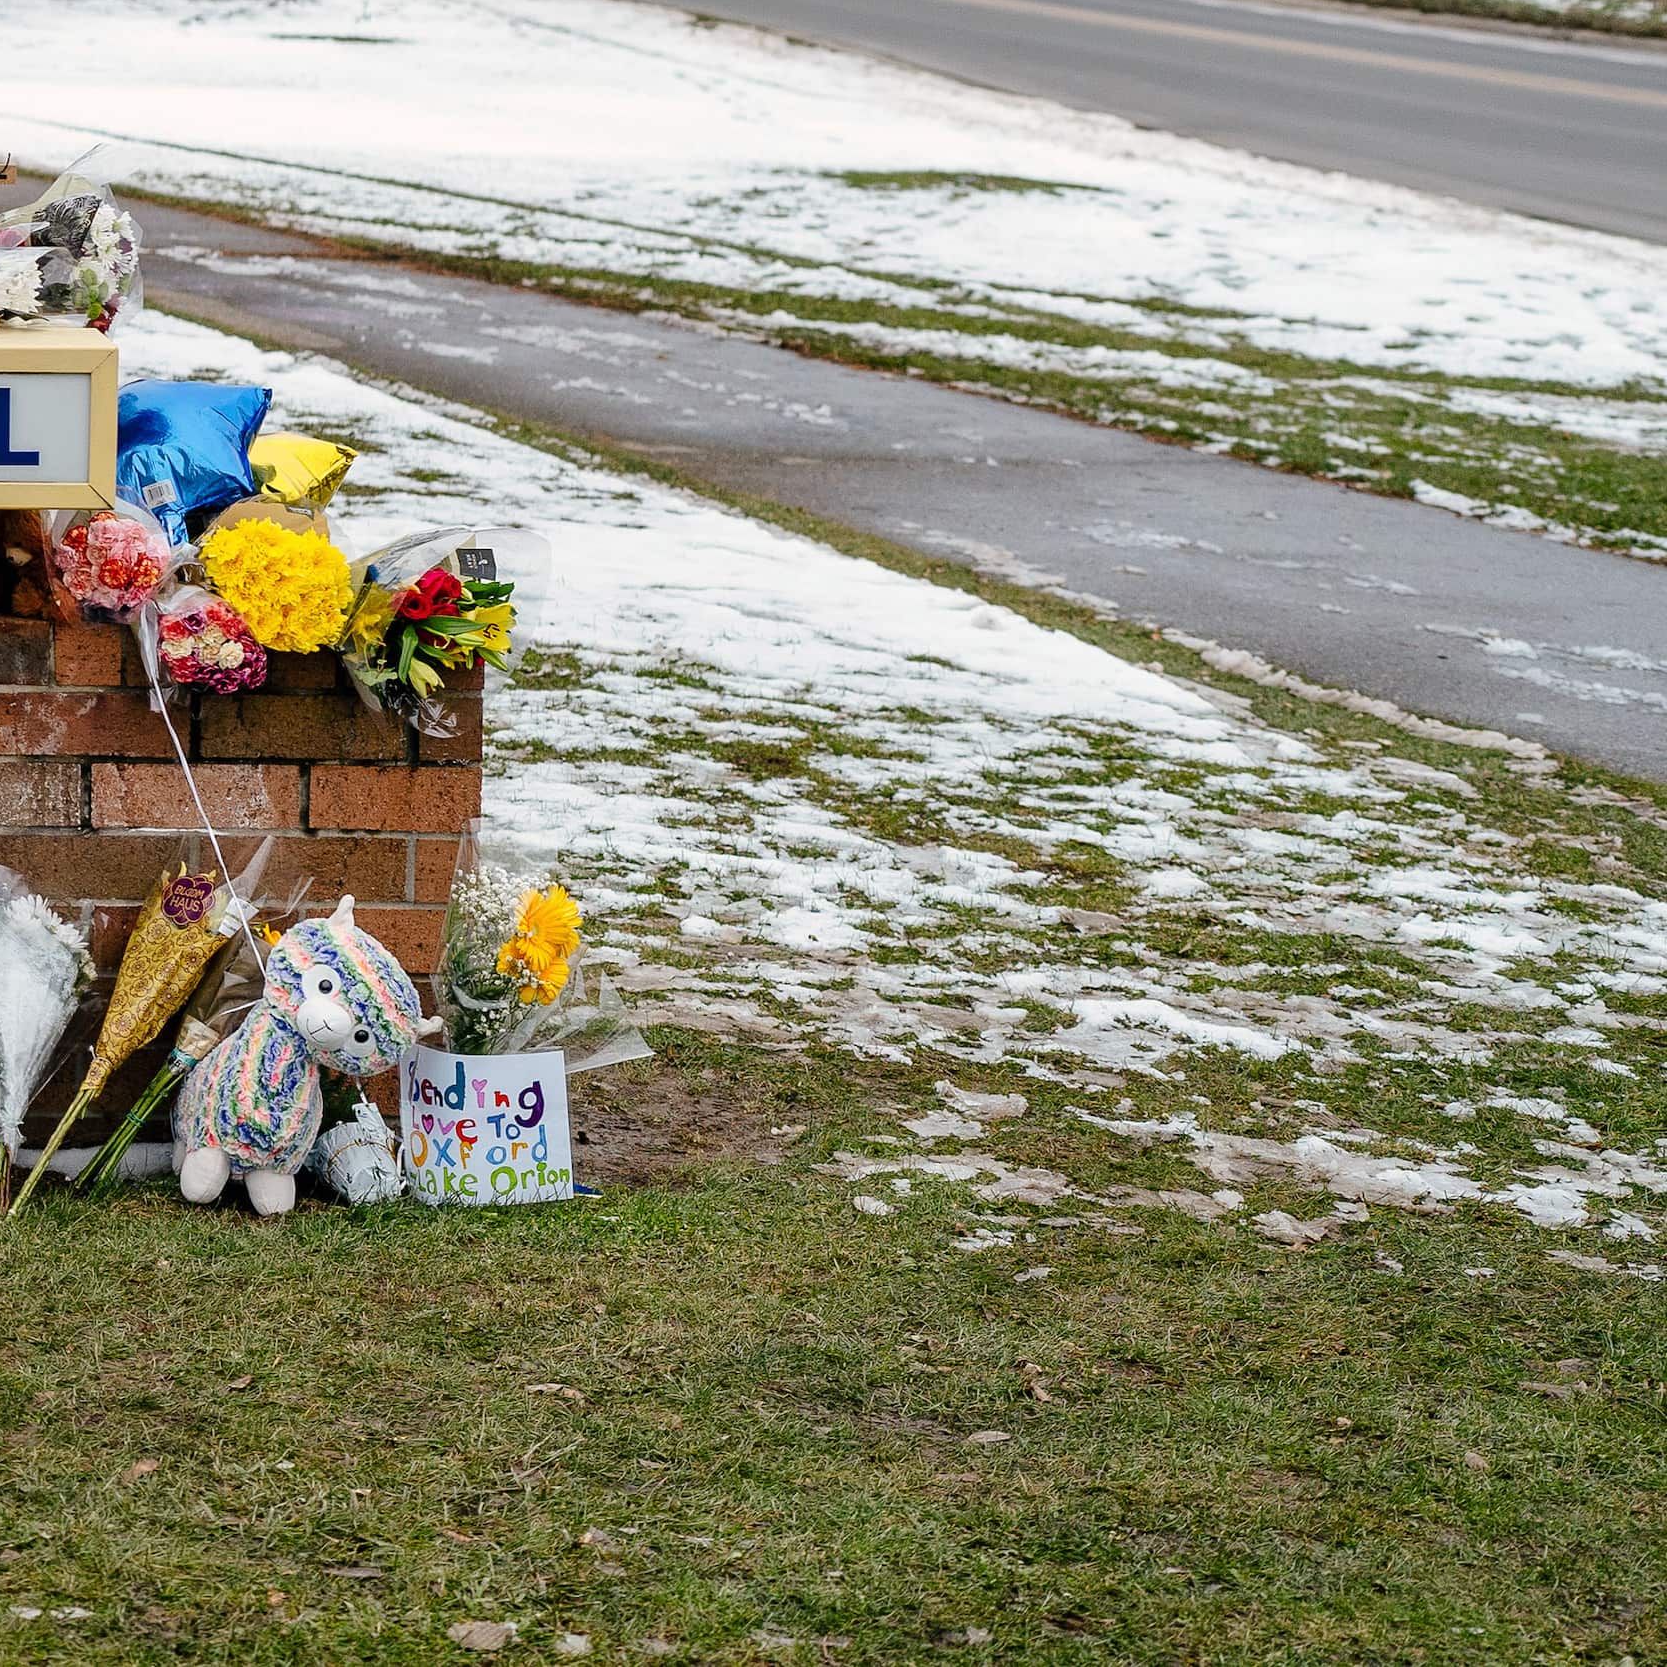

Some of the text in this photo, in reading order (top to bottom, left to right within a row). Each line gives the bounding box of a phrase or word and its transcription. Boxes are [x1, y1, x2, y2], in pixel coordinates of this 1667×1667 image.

[174, 884, 205, 900] BLOOM
[170, 894, 201, 913] HAUS
[490, 1161, 571, 1197] Orion
